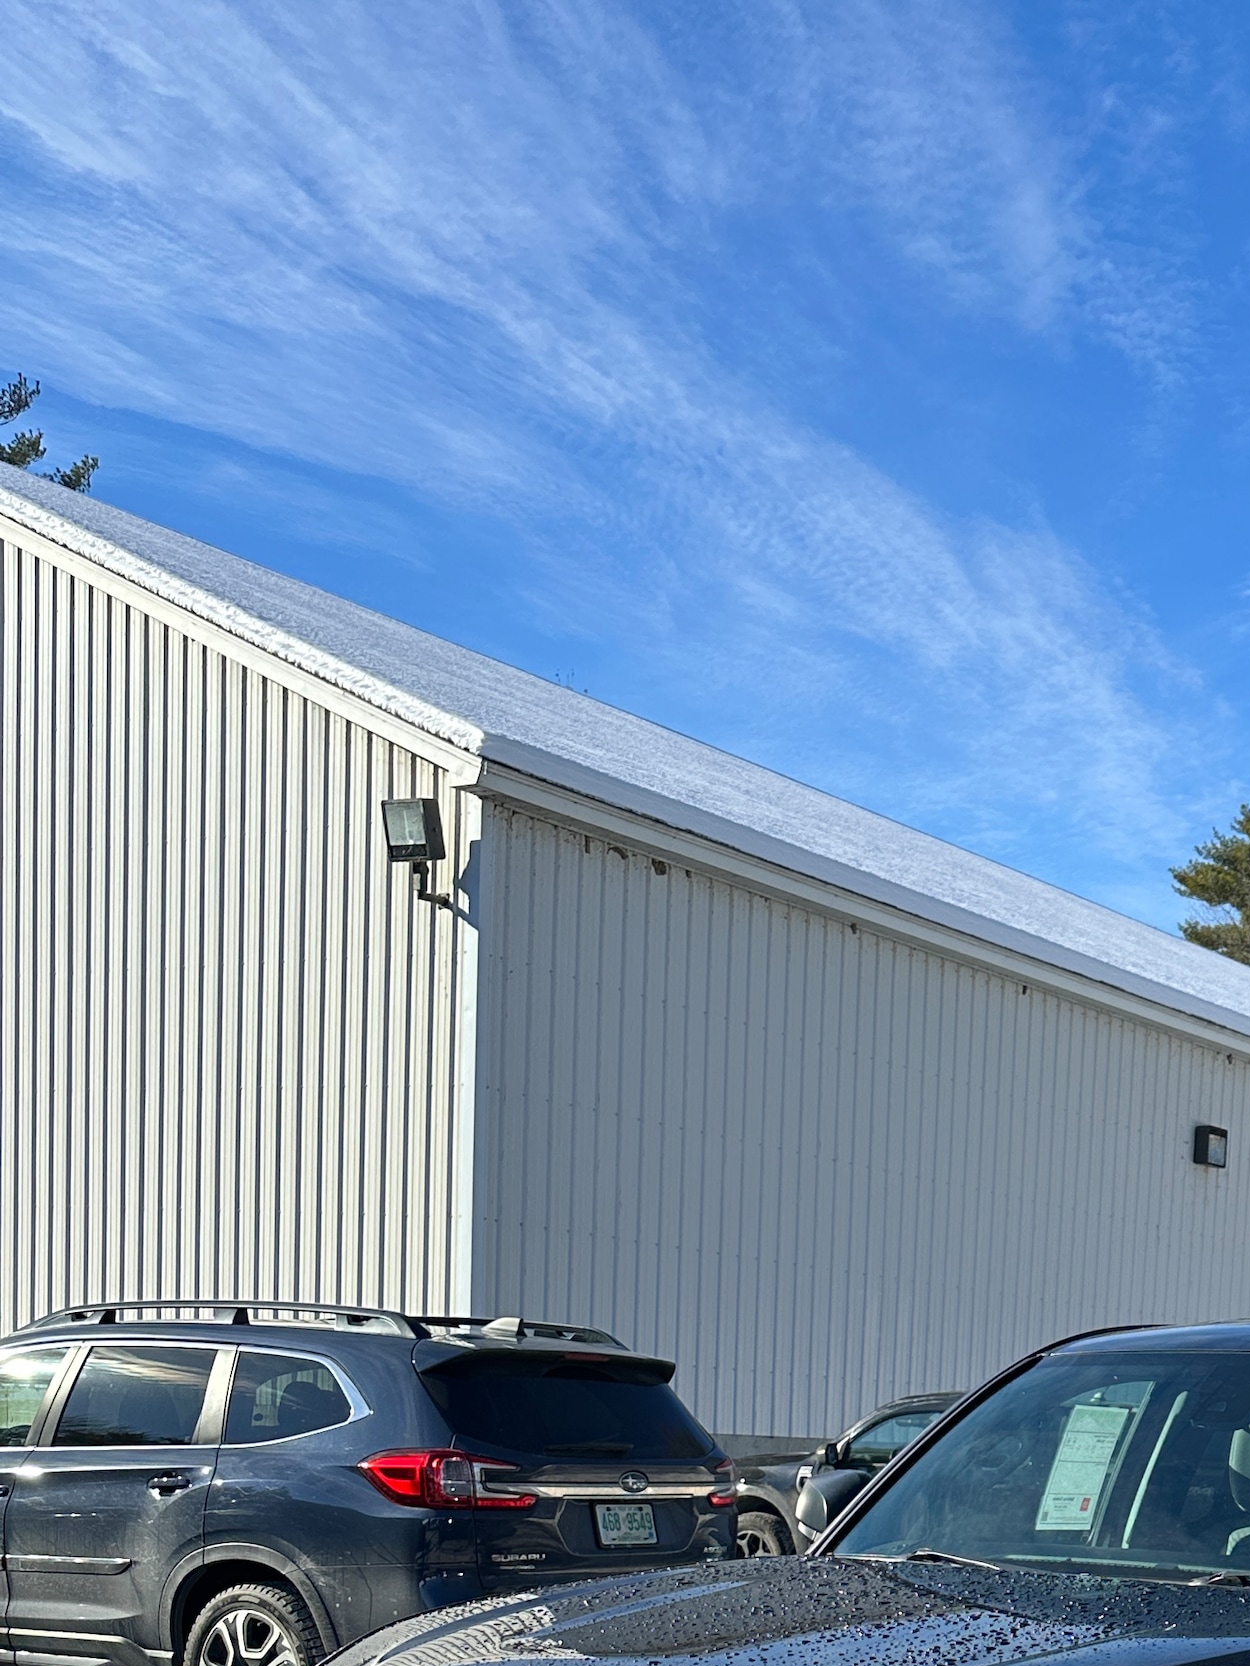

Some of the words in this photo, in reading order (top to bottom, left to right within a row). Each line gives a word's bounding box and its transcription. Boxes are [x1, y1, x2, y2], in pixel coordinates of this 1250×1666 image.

[602, 1512, 621, 1531] 468
[626, 1512, 653, 1531] 9549
[491, 1553, 546, 1562] SUBARU
